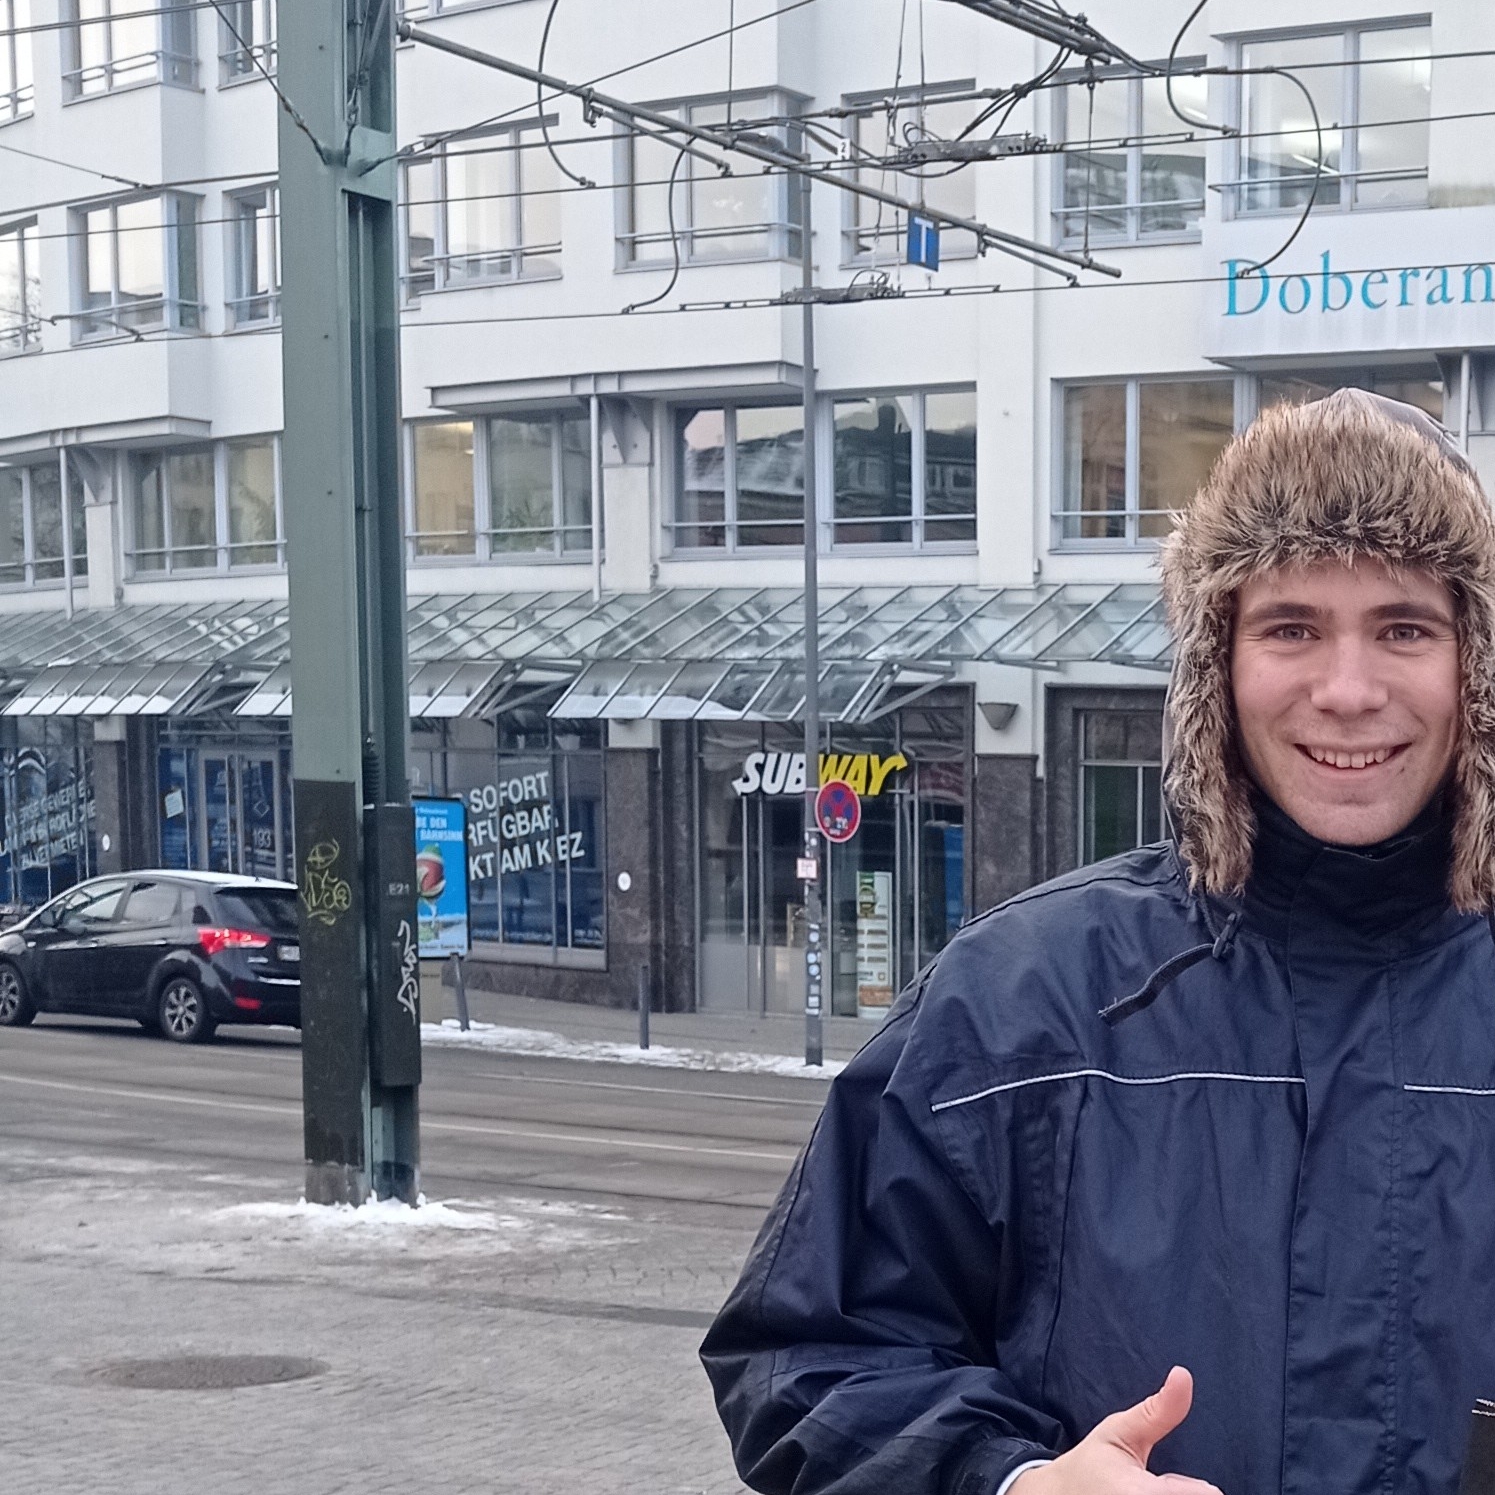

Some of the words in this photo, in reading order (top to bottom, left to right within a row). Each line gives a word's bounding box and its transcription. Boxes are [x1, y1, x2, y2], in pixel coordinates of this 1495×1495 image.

[913, 216, 935, 264] T
[470, 770, 549, 814] SOFORT
[732, 752, 908, 796] SUBWAY
[501, 843, 533, 875] AM
[537, 831, 586, 867] KEZ
